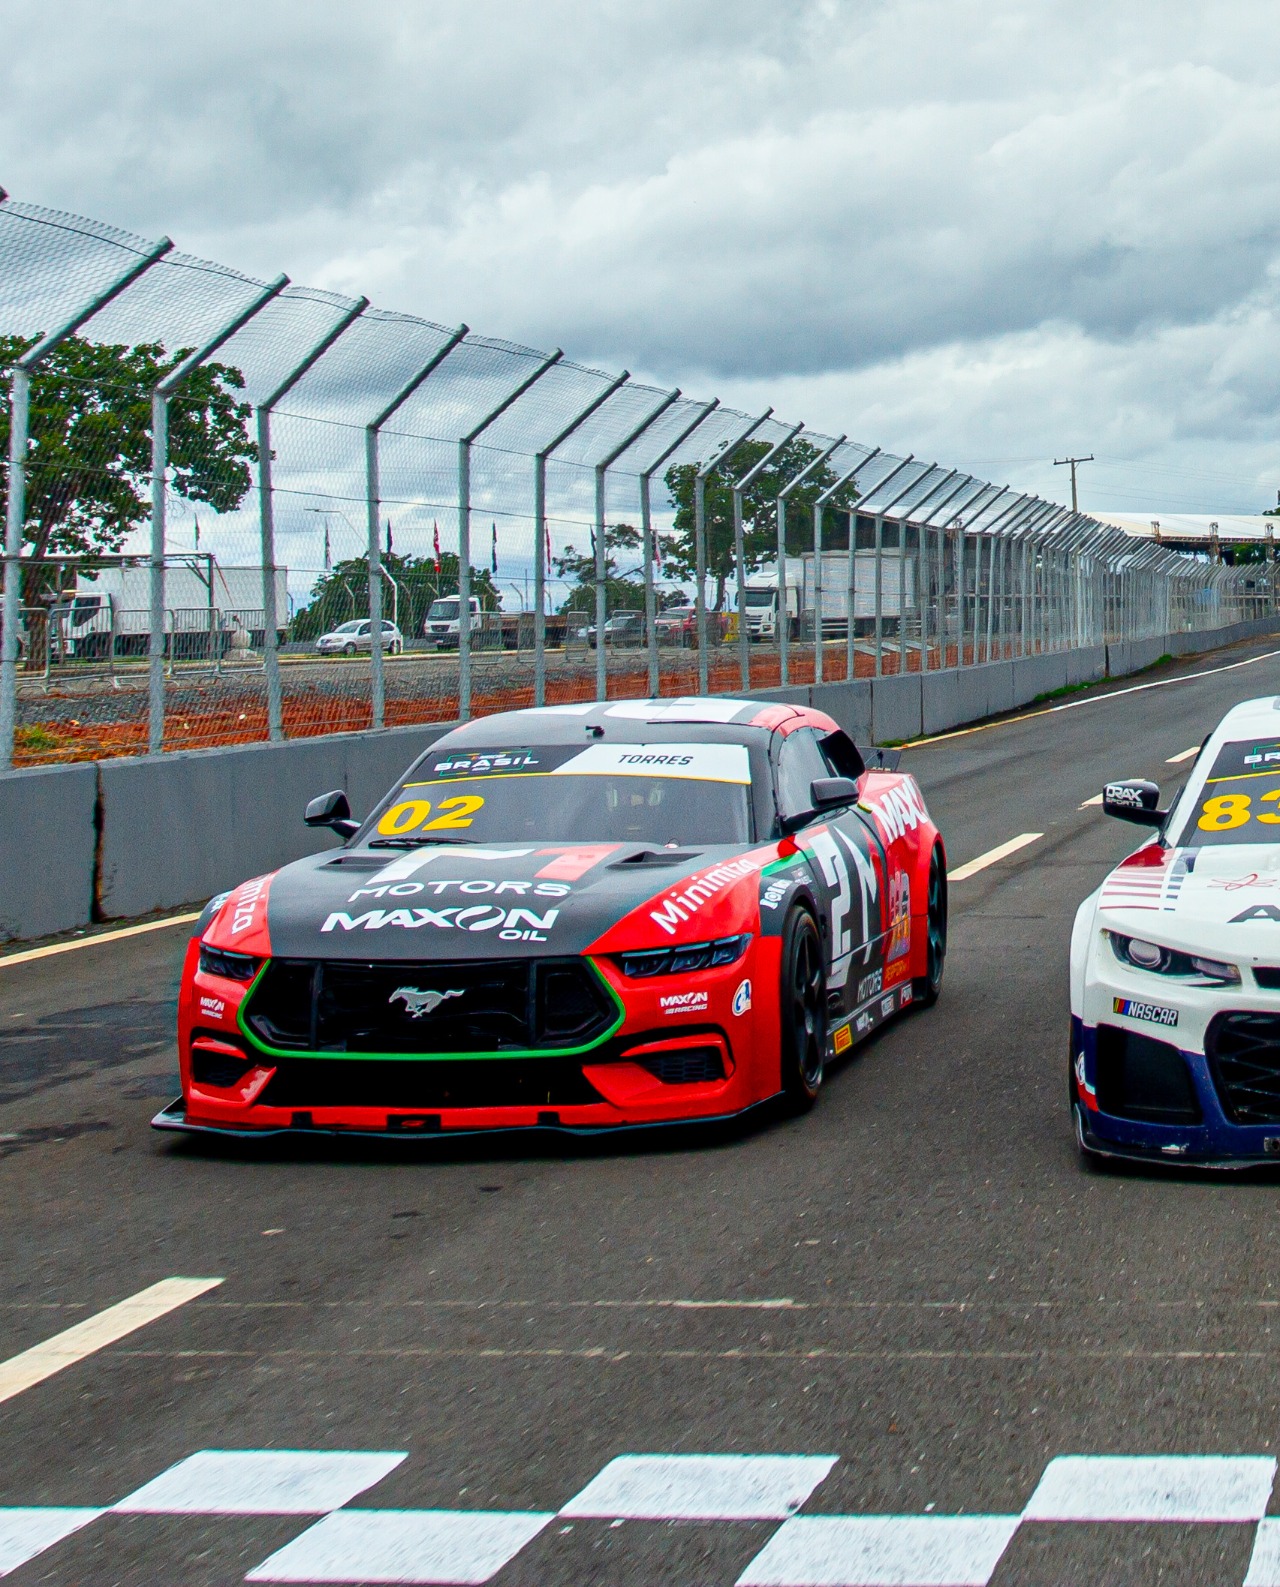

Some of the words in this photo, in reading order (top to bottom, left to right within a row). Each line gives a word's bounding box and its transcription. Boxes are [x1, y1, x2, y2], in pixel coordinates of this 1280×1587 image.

[434, 756, 540, 772] BRASIL
[616, 753, 694, 767] TORRES
[1105, 785, 1143, 802] DRAX
[377, 794, 485, 836] 02
[347, 880, 572, 903] MOTORS
[649, 858, 761, 936] Minimiza
[320, 905, 560, 933] MAXON
[499, 929, 548, 942] OIL
[660, 992, 708, 1008] MAXON
[1127, 1001, 1178, 1026] NASCAR
